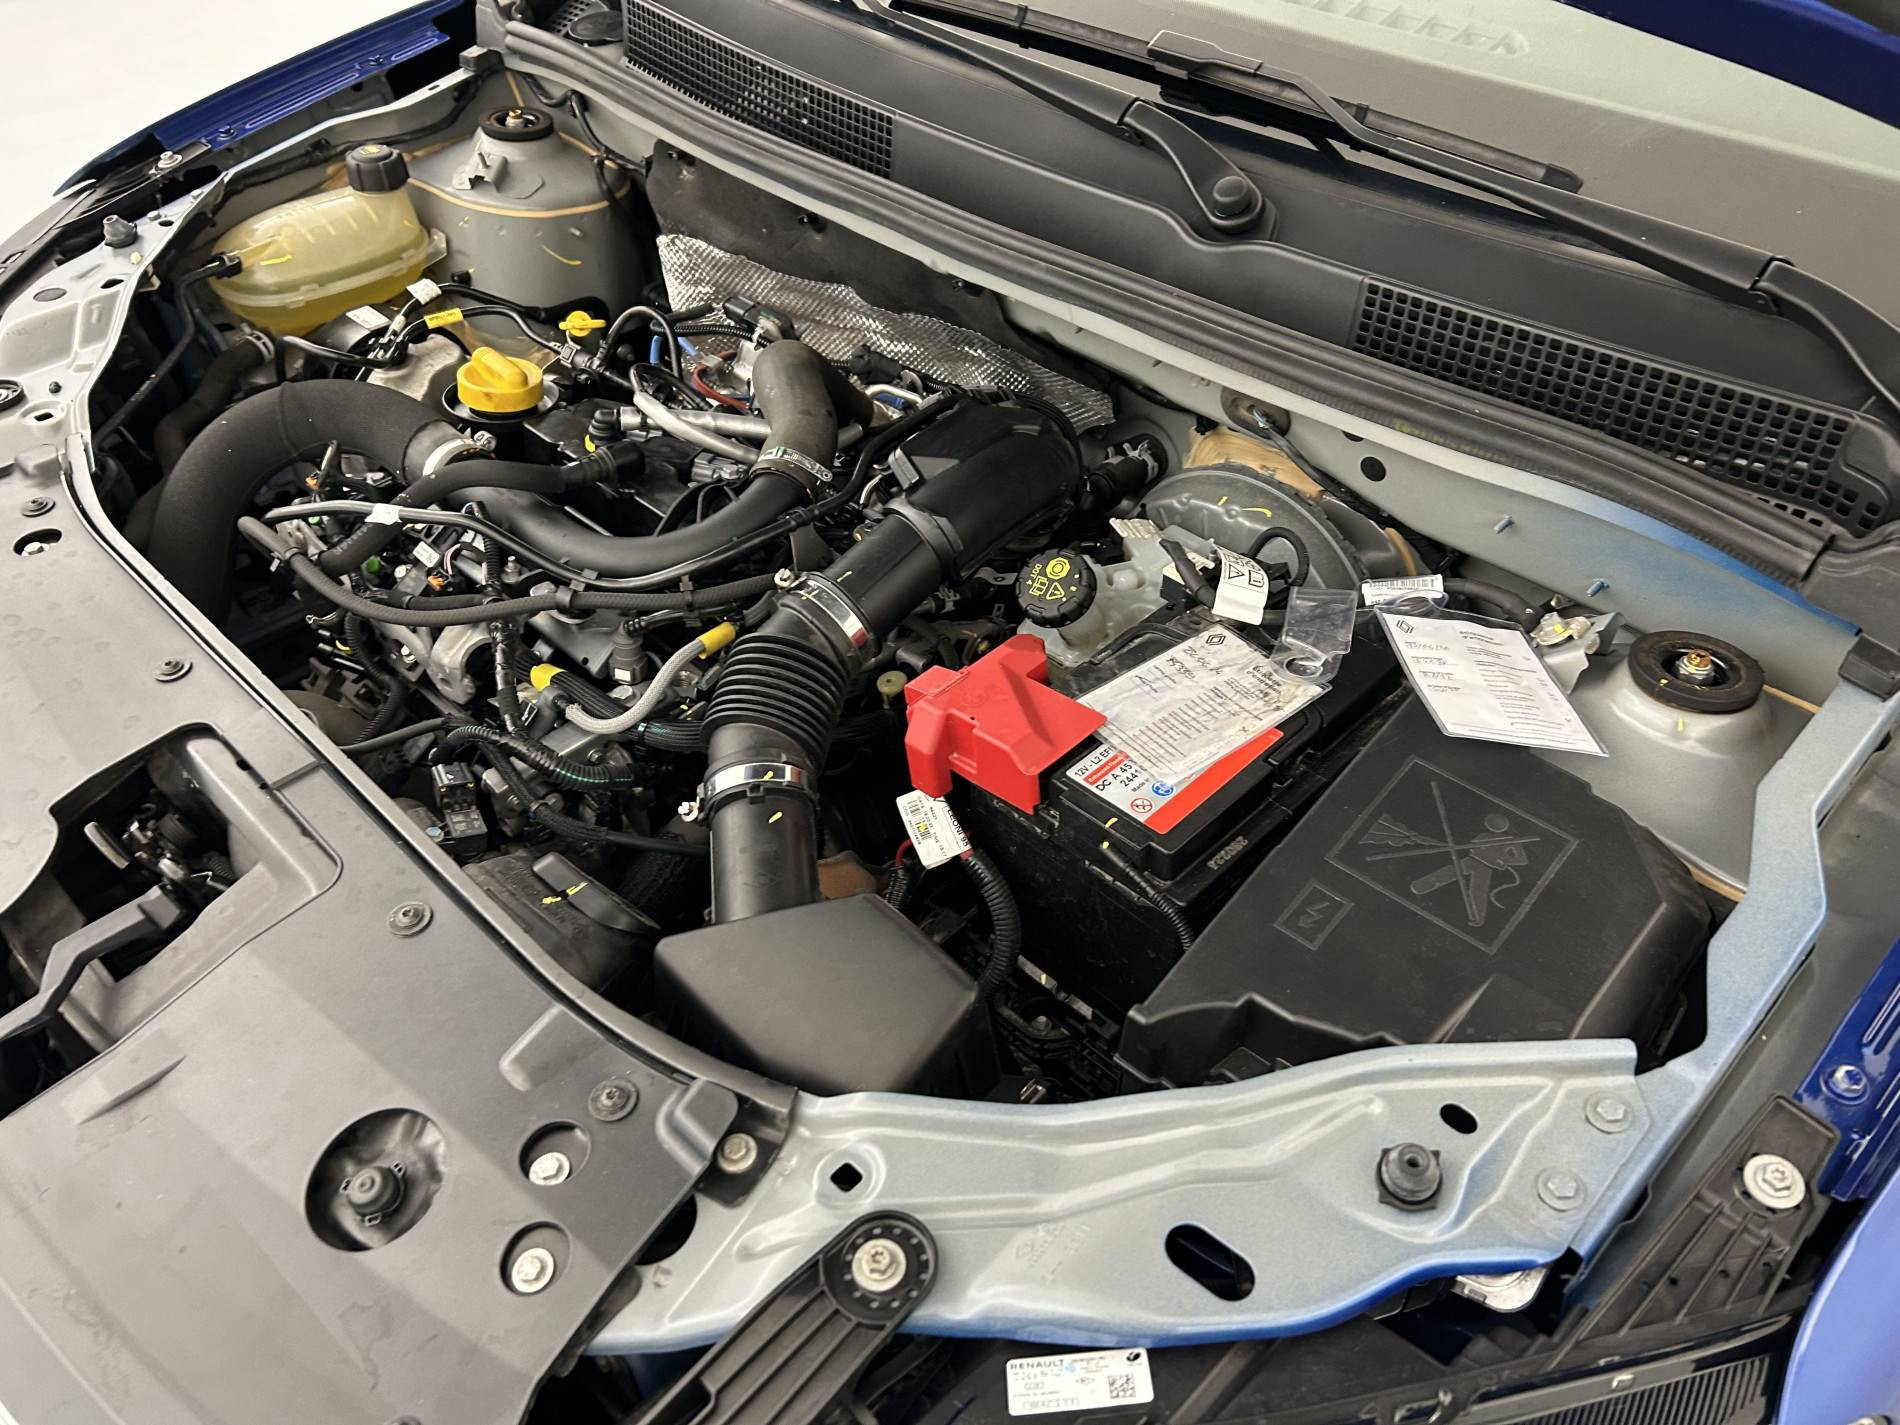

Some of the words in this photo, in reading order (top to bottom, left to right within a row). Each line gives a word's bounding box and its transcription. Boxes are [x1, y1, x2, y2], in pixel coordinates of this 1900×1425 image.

[1030, 563, 1042, 579] DOT
[1074, 766, 1089, 777] 12V
[1090, 755, 1102, 765] L2
[1095, 779, 1111, 792] DC
[1111, 772, 1121, 781] A
[1010, 1358, 1064, 1370] RENAULT
